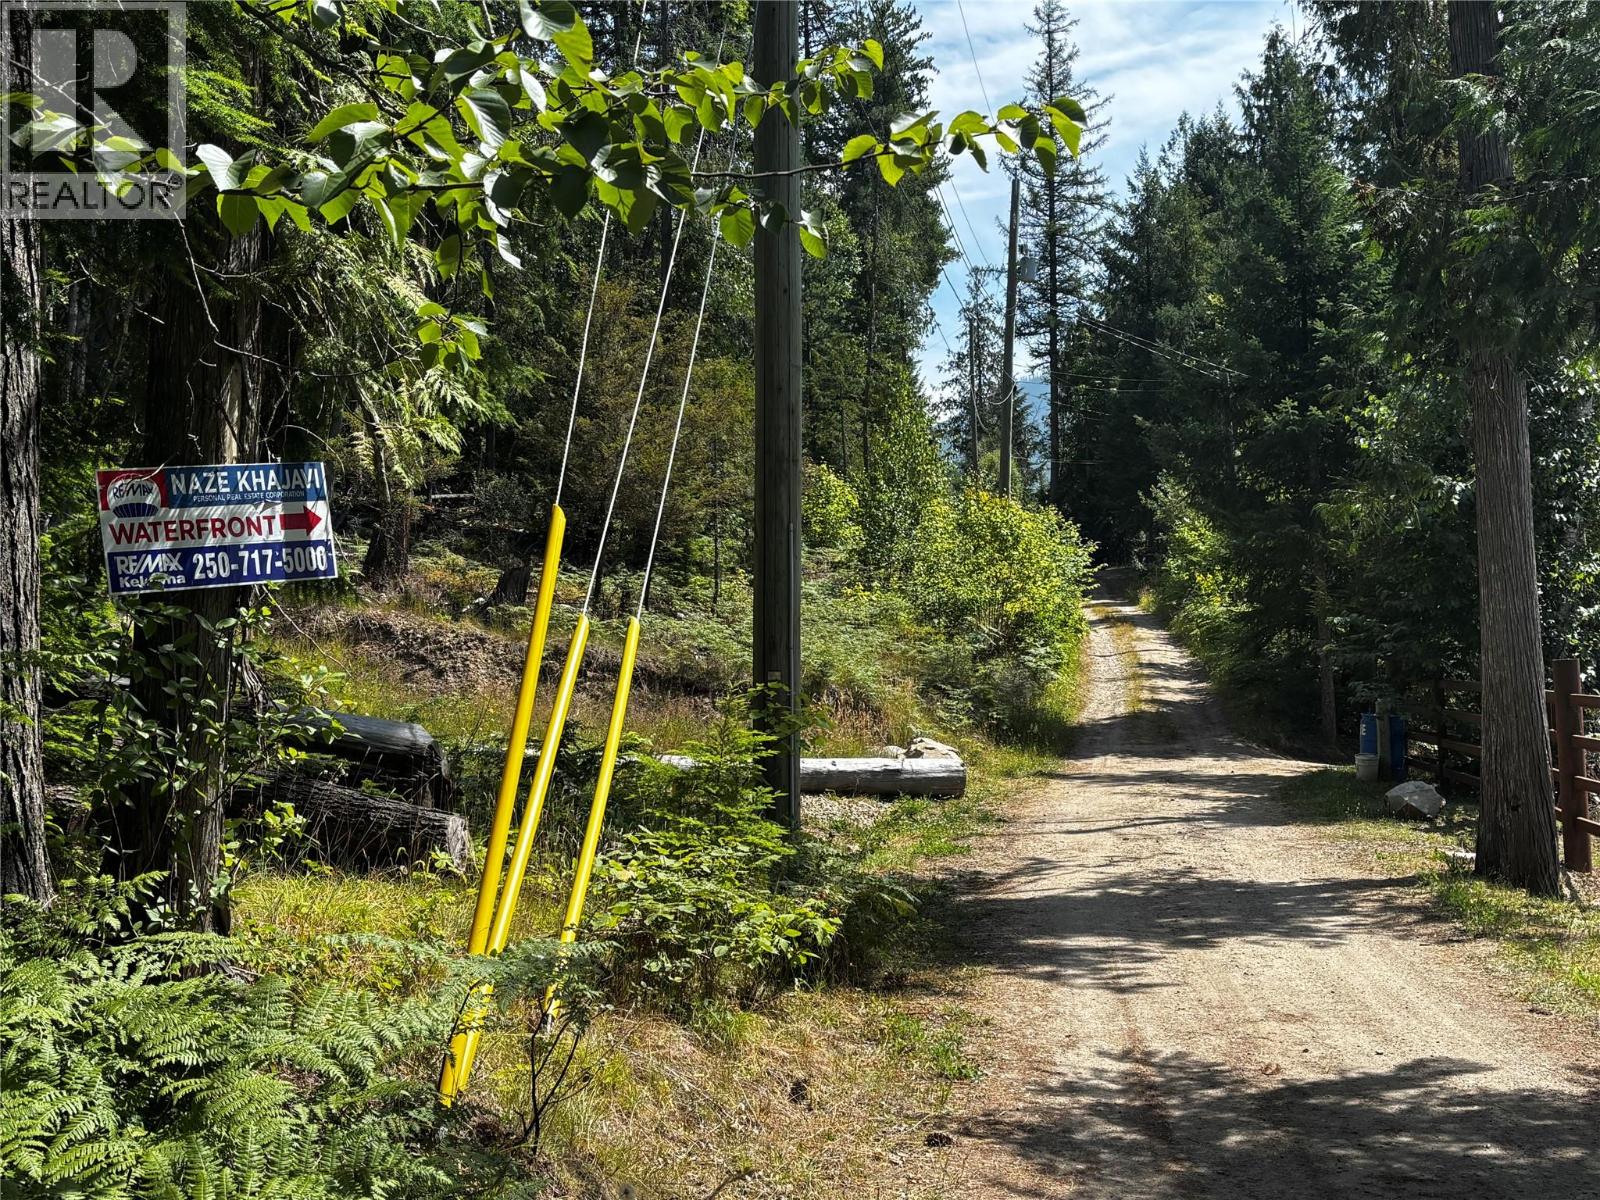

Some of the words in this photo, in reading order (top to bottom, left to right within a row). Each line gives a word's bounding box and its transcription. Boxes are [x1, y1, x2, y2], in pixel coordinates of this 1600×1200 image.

[171, 472, 230, 495] NAZE
[236, 468, 321, 493] KHAJAVI
[244, 491, 264, 500] ESTATE
[265, 490, 305, 499] CORPORATION
[109, 516, 275, 545] WATERFRONT
[114, 553, 184, 575] RE/MAX
[192, 545, 327, 579] 250-717-5000
[119, 574, 186, 588] Kelna
